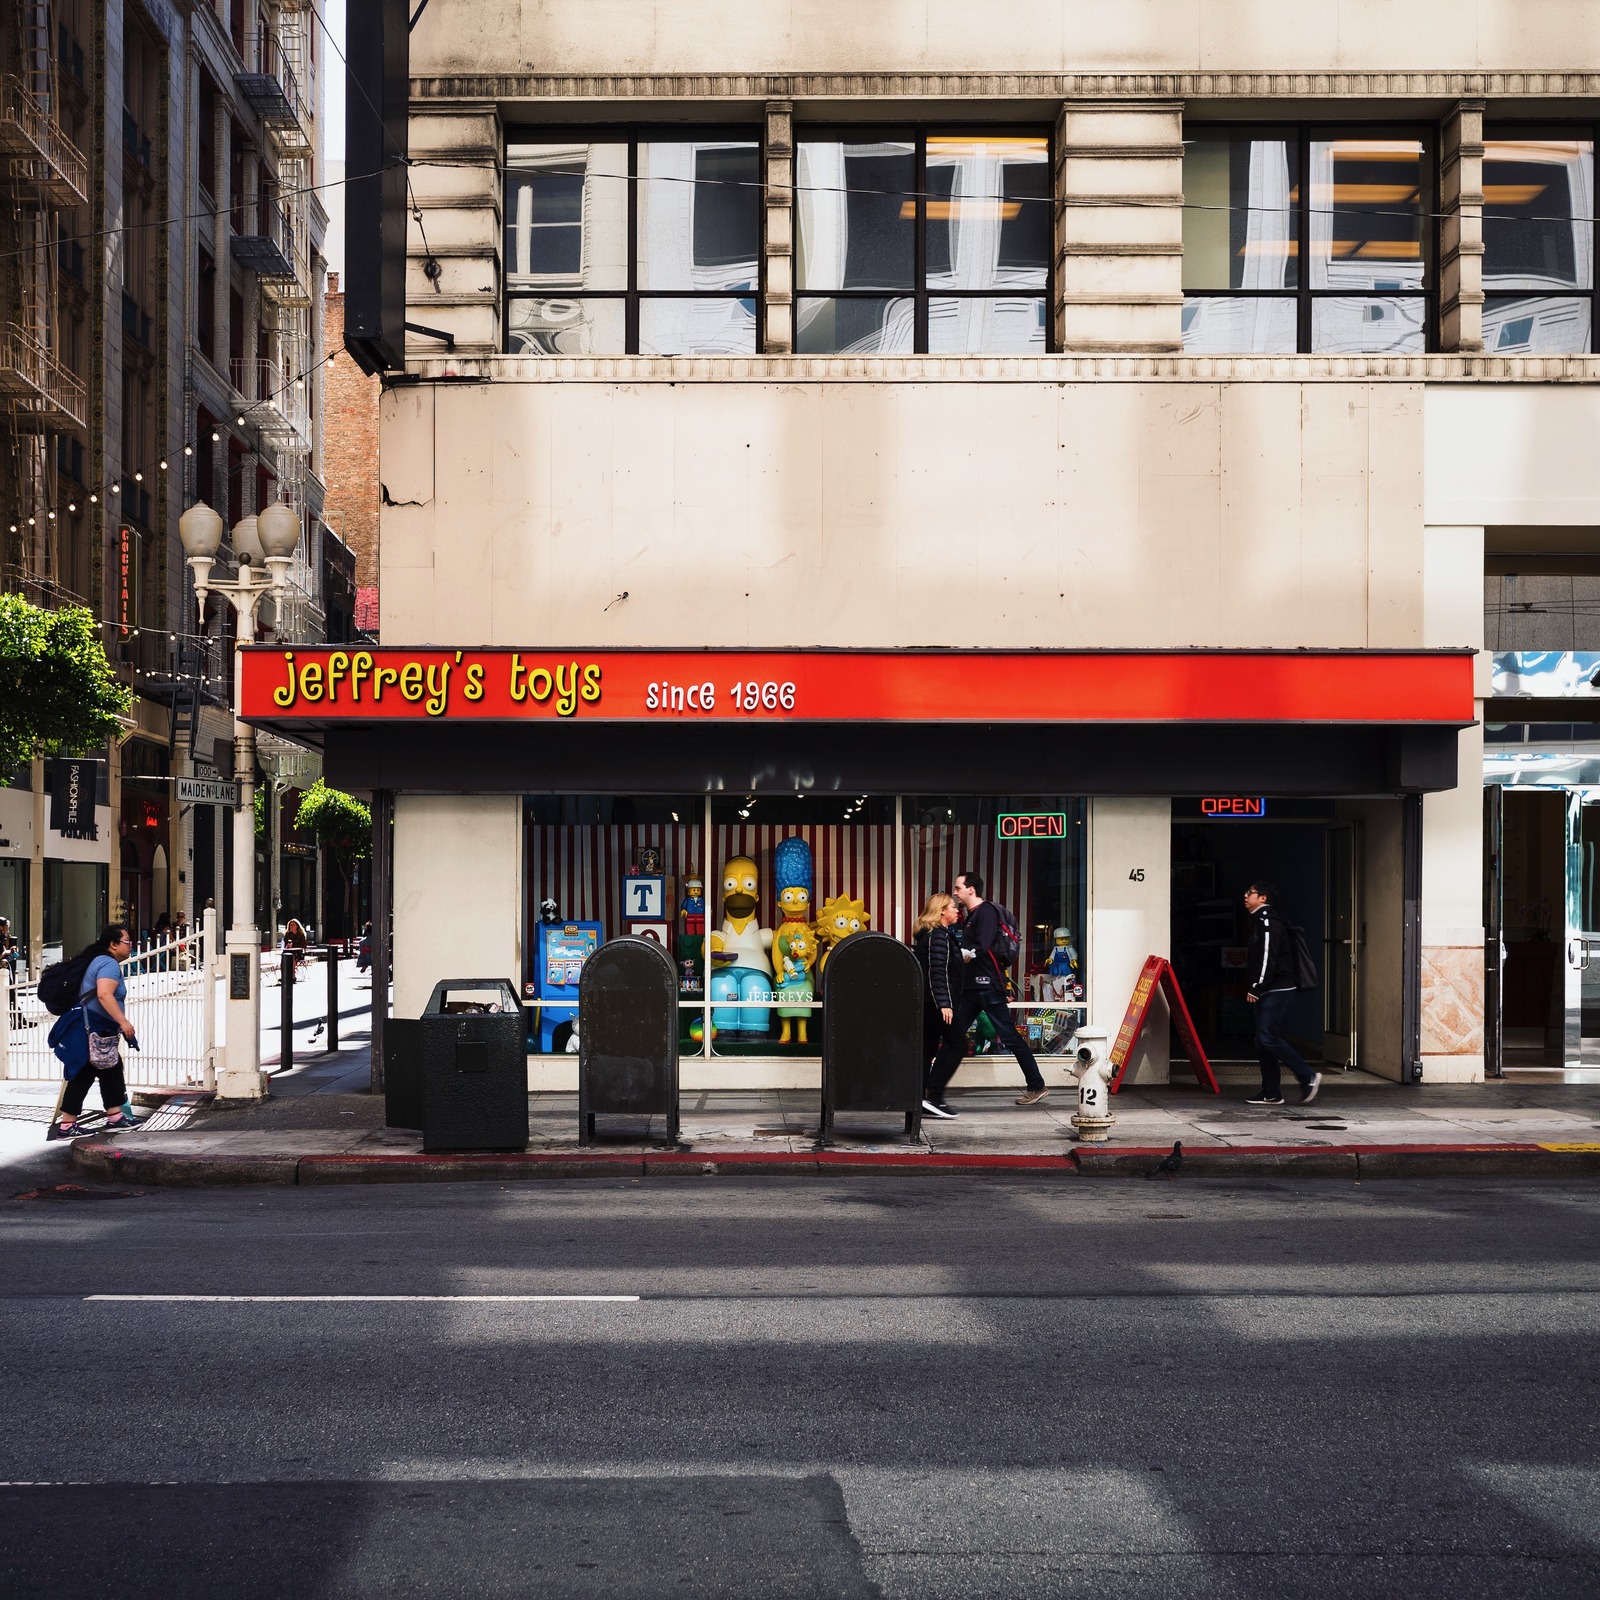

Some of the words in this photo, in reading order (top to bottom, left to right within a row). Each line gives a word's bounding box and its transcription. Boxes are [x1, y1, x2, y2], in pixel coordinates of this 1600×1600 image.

[121, 529, 129, 635] COCKTAILS
[273, 650, 484, 716] jeffrey's
[509, 653, 600, 716] toys
[645, 681, 716, 712] since
[730, 681, 797, 711] 1966
[68, 765, 79, 824] FASHIONPHILE
[180, 782, 211, 799] MAIDEN
[215, 785, 235, 801] LANE
[1201, 798, 1260, 813] OPEN
[1001, 815, 1063, 836] OPEN
[1128, 868, 1145, 882] 45
[633, 884, 653, 912] T
[1080, 1087, 1097, 1106] 12
